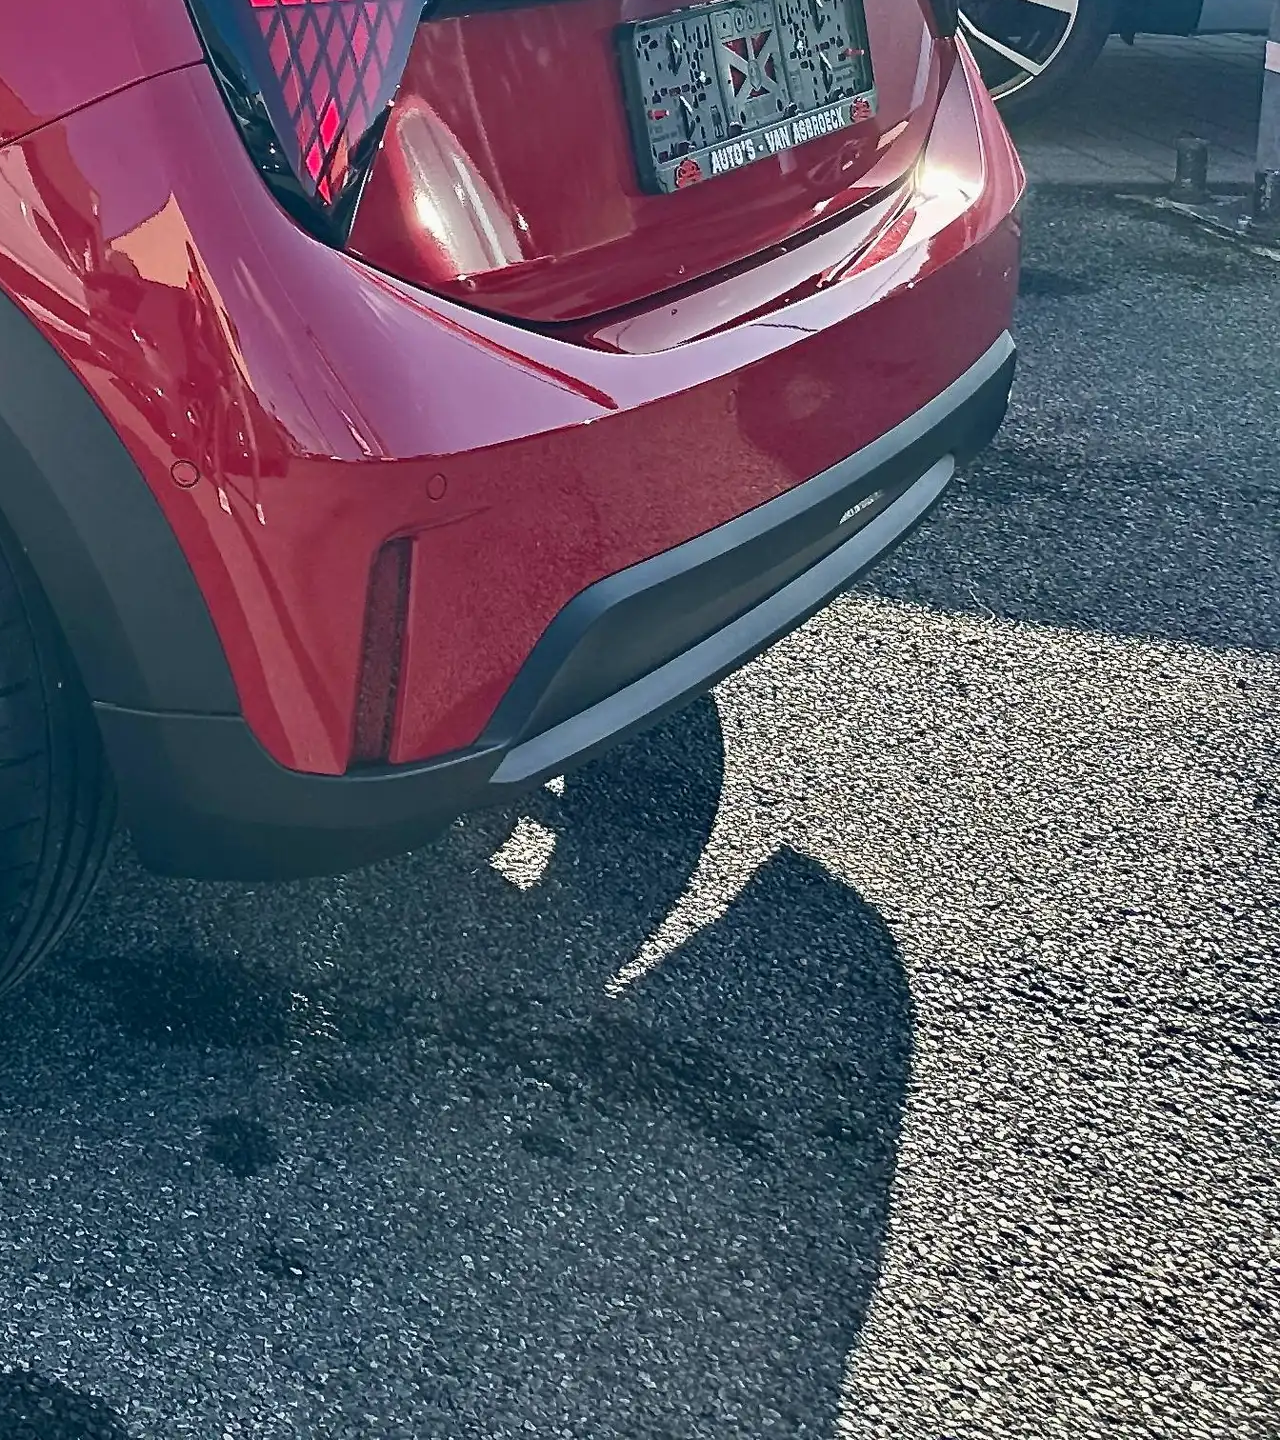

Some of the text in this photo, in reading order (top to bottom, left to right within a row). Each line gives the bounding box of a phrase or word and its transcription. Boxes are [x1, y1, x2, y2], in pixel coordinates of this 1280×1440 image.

[710, 107, 845, 175] AUTO'S VAN ASBROECK
